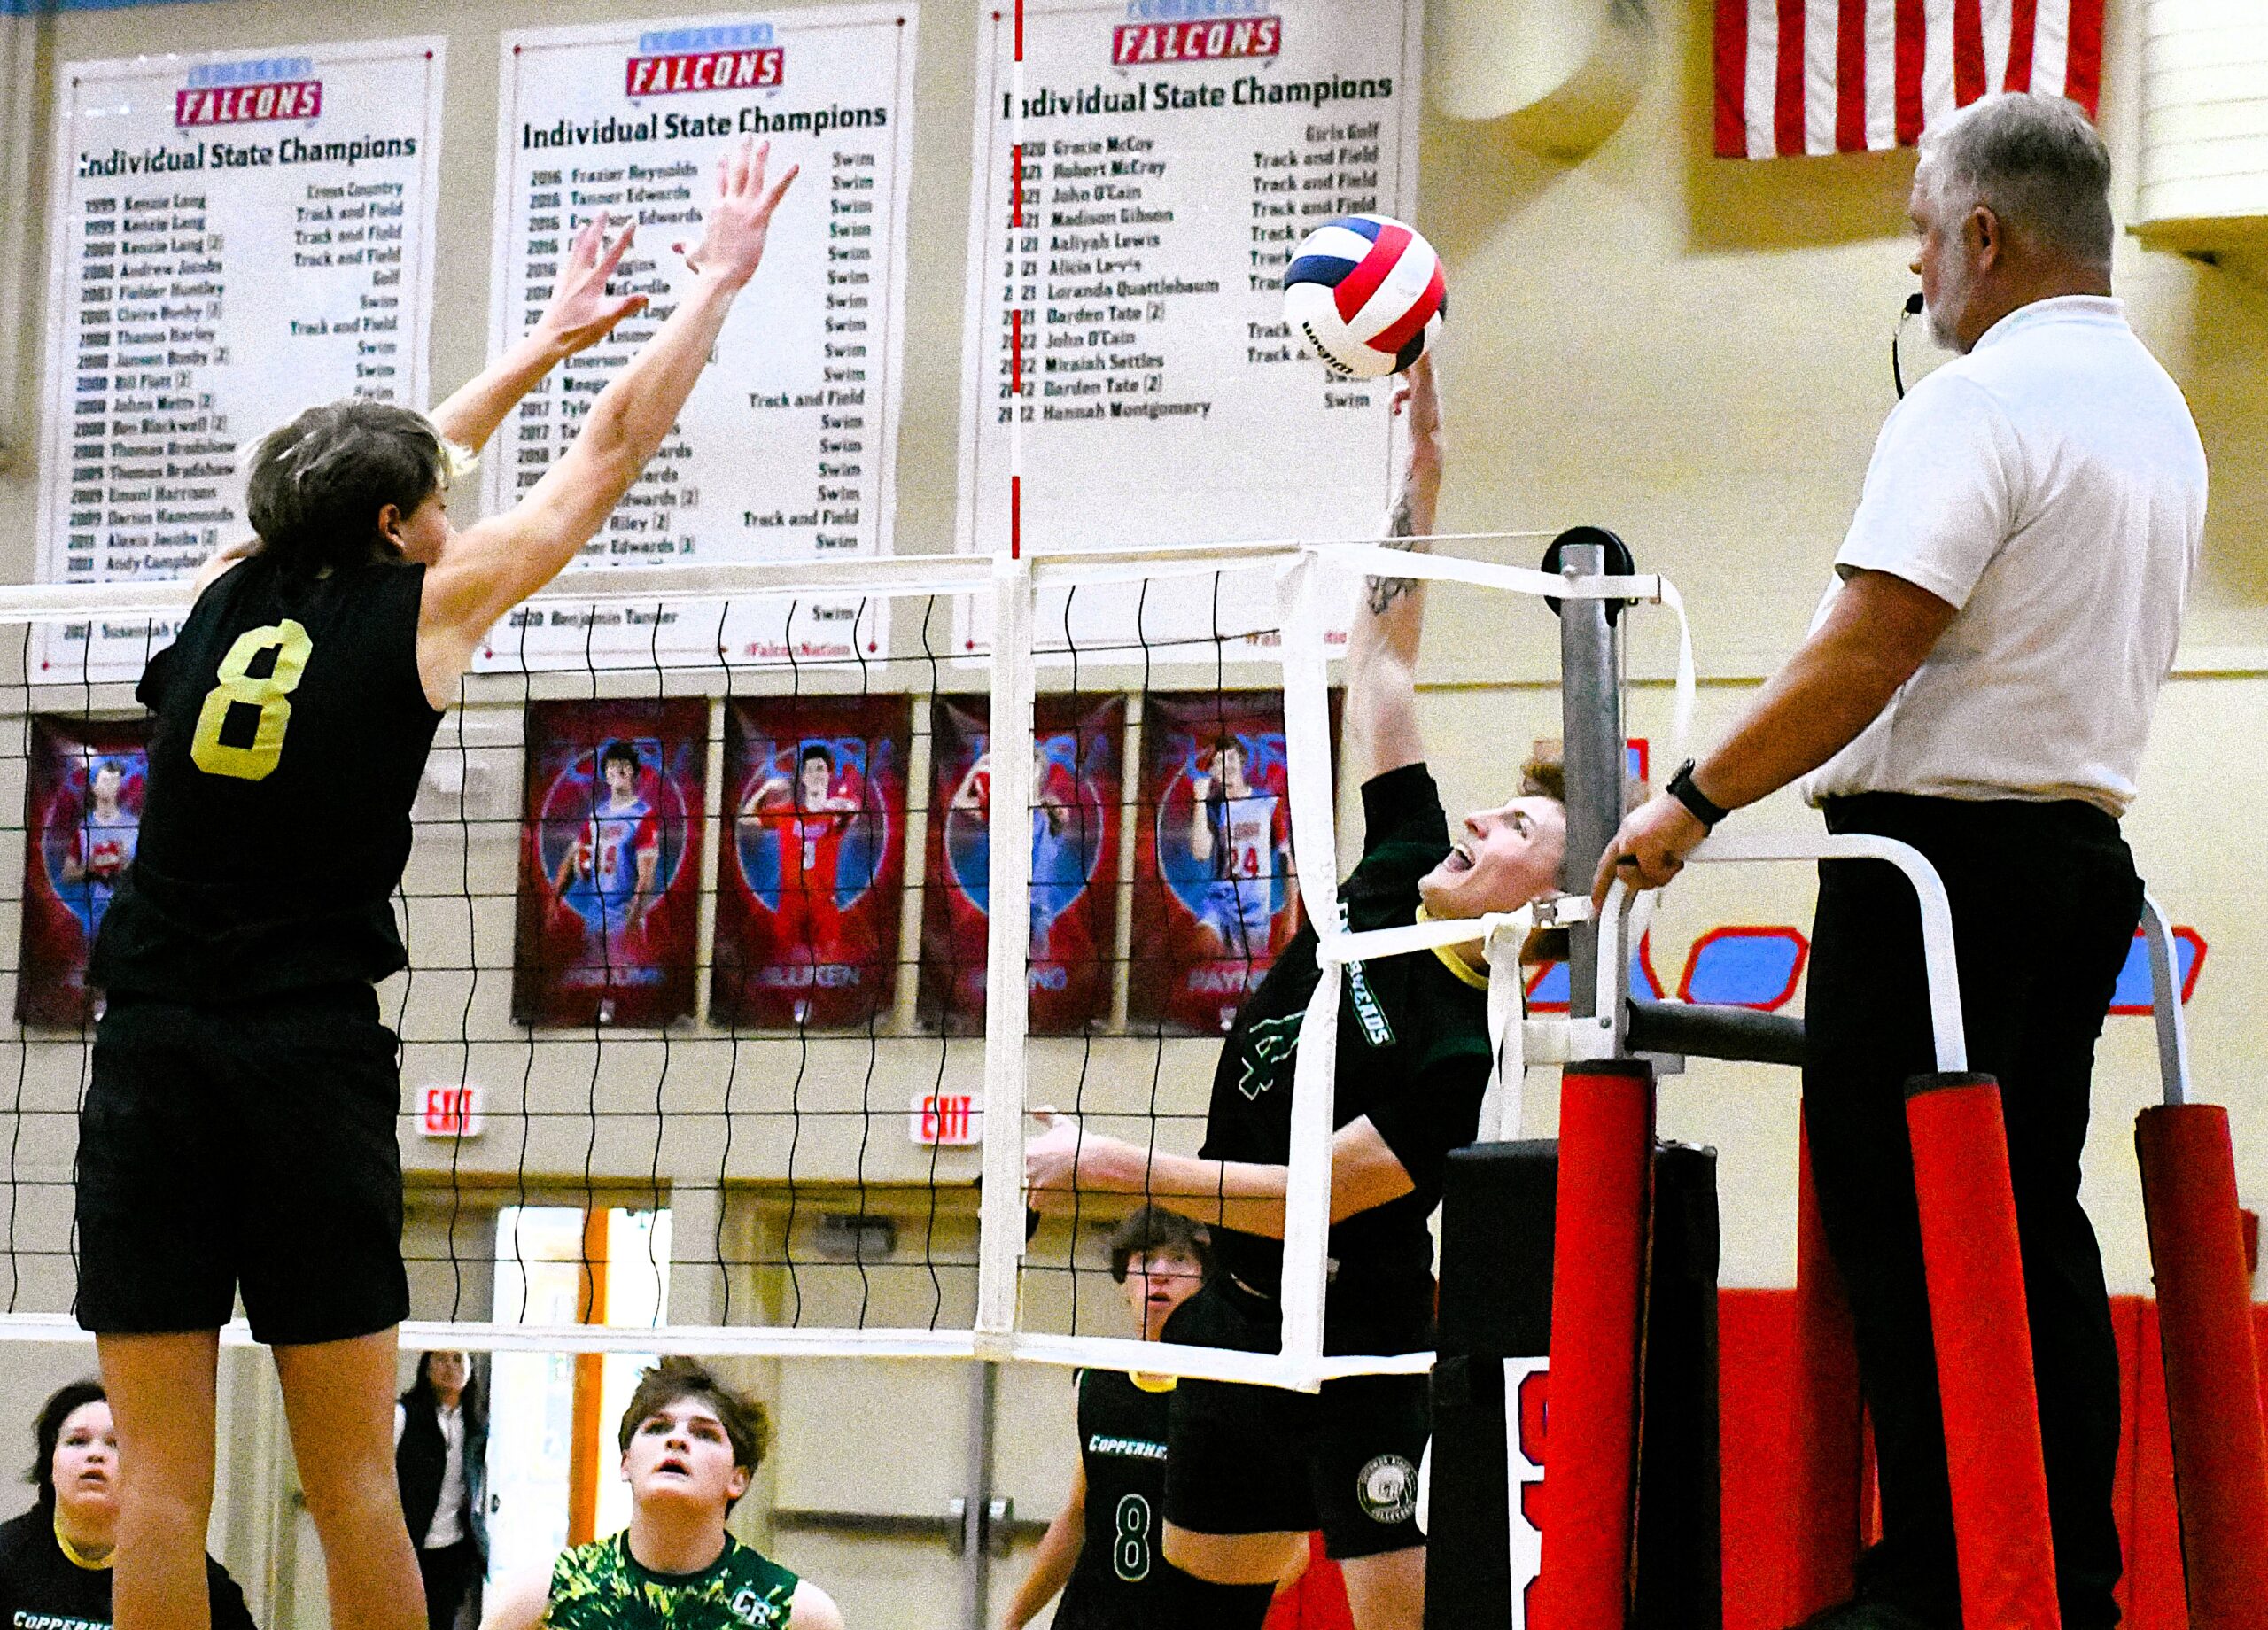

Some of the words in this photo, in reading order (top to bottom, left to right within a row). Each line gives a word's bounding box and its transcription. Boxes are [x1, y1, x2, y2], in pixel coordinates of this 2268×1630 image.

[1118, 19, 1277, 61] FALCONS
[631, 51, 779, 92] FALCONS
[1153, 82, 1225, 110] State
[1231, 74, 1393, 108] Champions
[181, 85, 318, 122] FALCONS
[524, 113, 658, 149] Individual
[664, 112, 731, 140] State
[739, 104, 886, 136] Champions
[79, 143, 205, 177] Individual
[211, 143, 274, 169] State
[280, 135, 416, 166] Champions
[832, 151, 875, 167] Swim
[1254, 150, 1298, 168] Track
[1303, 149, 1335, 166] and
[1339, 144, 1379, 164] Field
[832, 175, 874, 191] Swim
[1253, 172, 1297, 192] Track
[1303, 171, 1333, 190] and
[1338, 169, 1379, 188] Field
[297, 204, 333, 221] Track
[831, 198, 873, 216] Swim
[1252, 198, 1296, 217] Track
[1301, 197, 1332, 214] and
[1336, 195, 1376, 213] Field
[639, 207, 703, 225] Edwards
[1051, 208, 1116, 228] Madison
[295, 227, 331, 245] Track
[829, 221, 871, 238] Swim
[1251, 223, 1295, 242] Track
[1115, 231, 1161, 248] Lewis
[294, 249, 331, 267] Track
[828, 245, 871, 262] Swim
[827, 269, 870, 286] Swim
[1117, 277, 1220, 298] Quattlebaum
[360, 294, 399, 308] Swim
[826, 293, 868, 310] Swim
[1108, 306, 1142, 322] Tate
[825, 315, 867, 332] Swim
[1248, 321, 1292, 338] Track
[357, 339, 397, 355] Swim
[1046, 331, 1084, 349] John
[825, 342, 866, 358] Swim
[1248, 345, 1291, 363] Track
[356, 361, 395, 378] Swim
[823, 366, 866, 383] Swim
[353, 385, 394, 400] Swim
[1107, 377, 1140, 394] Tate
[749, 392, 790, 408] Track
[827, 388, 865, 406] Field
[1324, 392, 1370, 409] Swim
[1044, 401, 1106, 420] Hannah
[1110, 401, 1212, 421] Montgomery
[821, 413, 864, 430] Swim
[819, 437, 863, 454] Swim
[819, 461, 861, 478] Swim
[817, 485, 859, 502] Swim
[742, 510, 785, 528] Track
[822, 508, 859, 526] Field
[815, 532, 858, 549] Swim
[813, 604, 855, 622] Swim
[190, 618, 313, 781] 8
[427, 1088, 473, 1132] EXIT
[921, 1095, 971, 1140] EXIT
[1089, 1433, 1168, 1460] COPPERHE
[1114, 1493, 1150, 1582] 8
